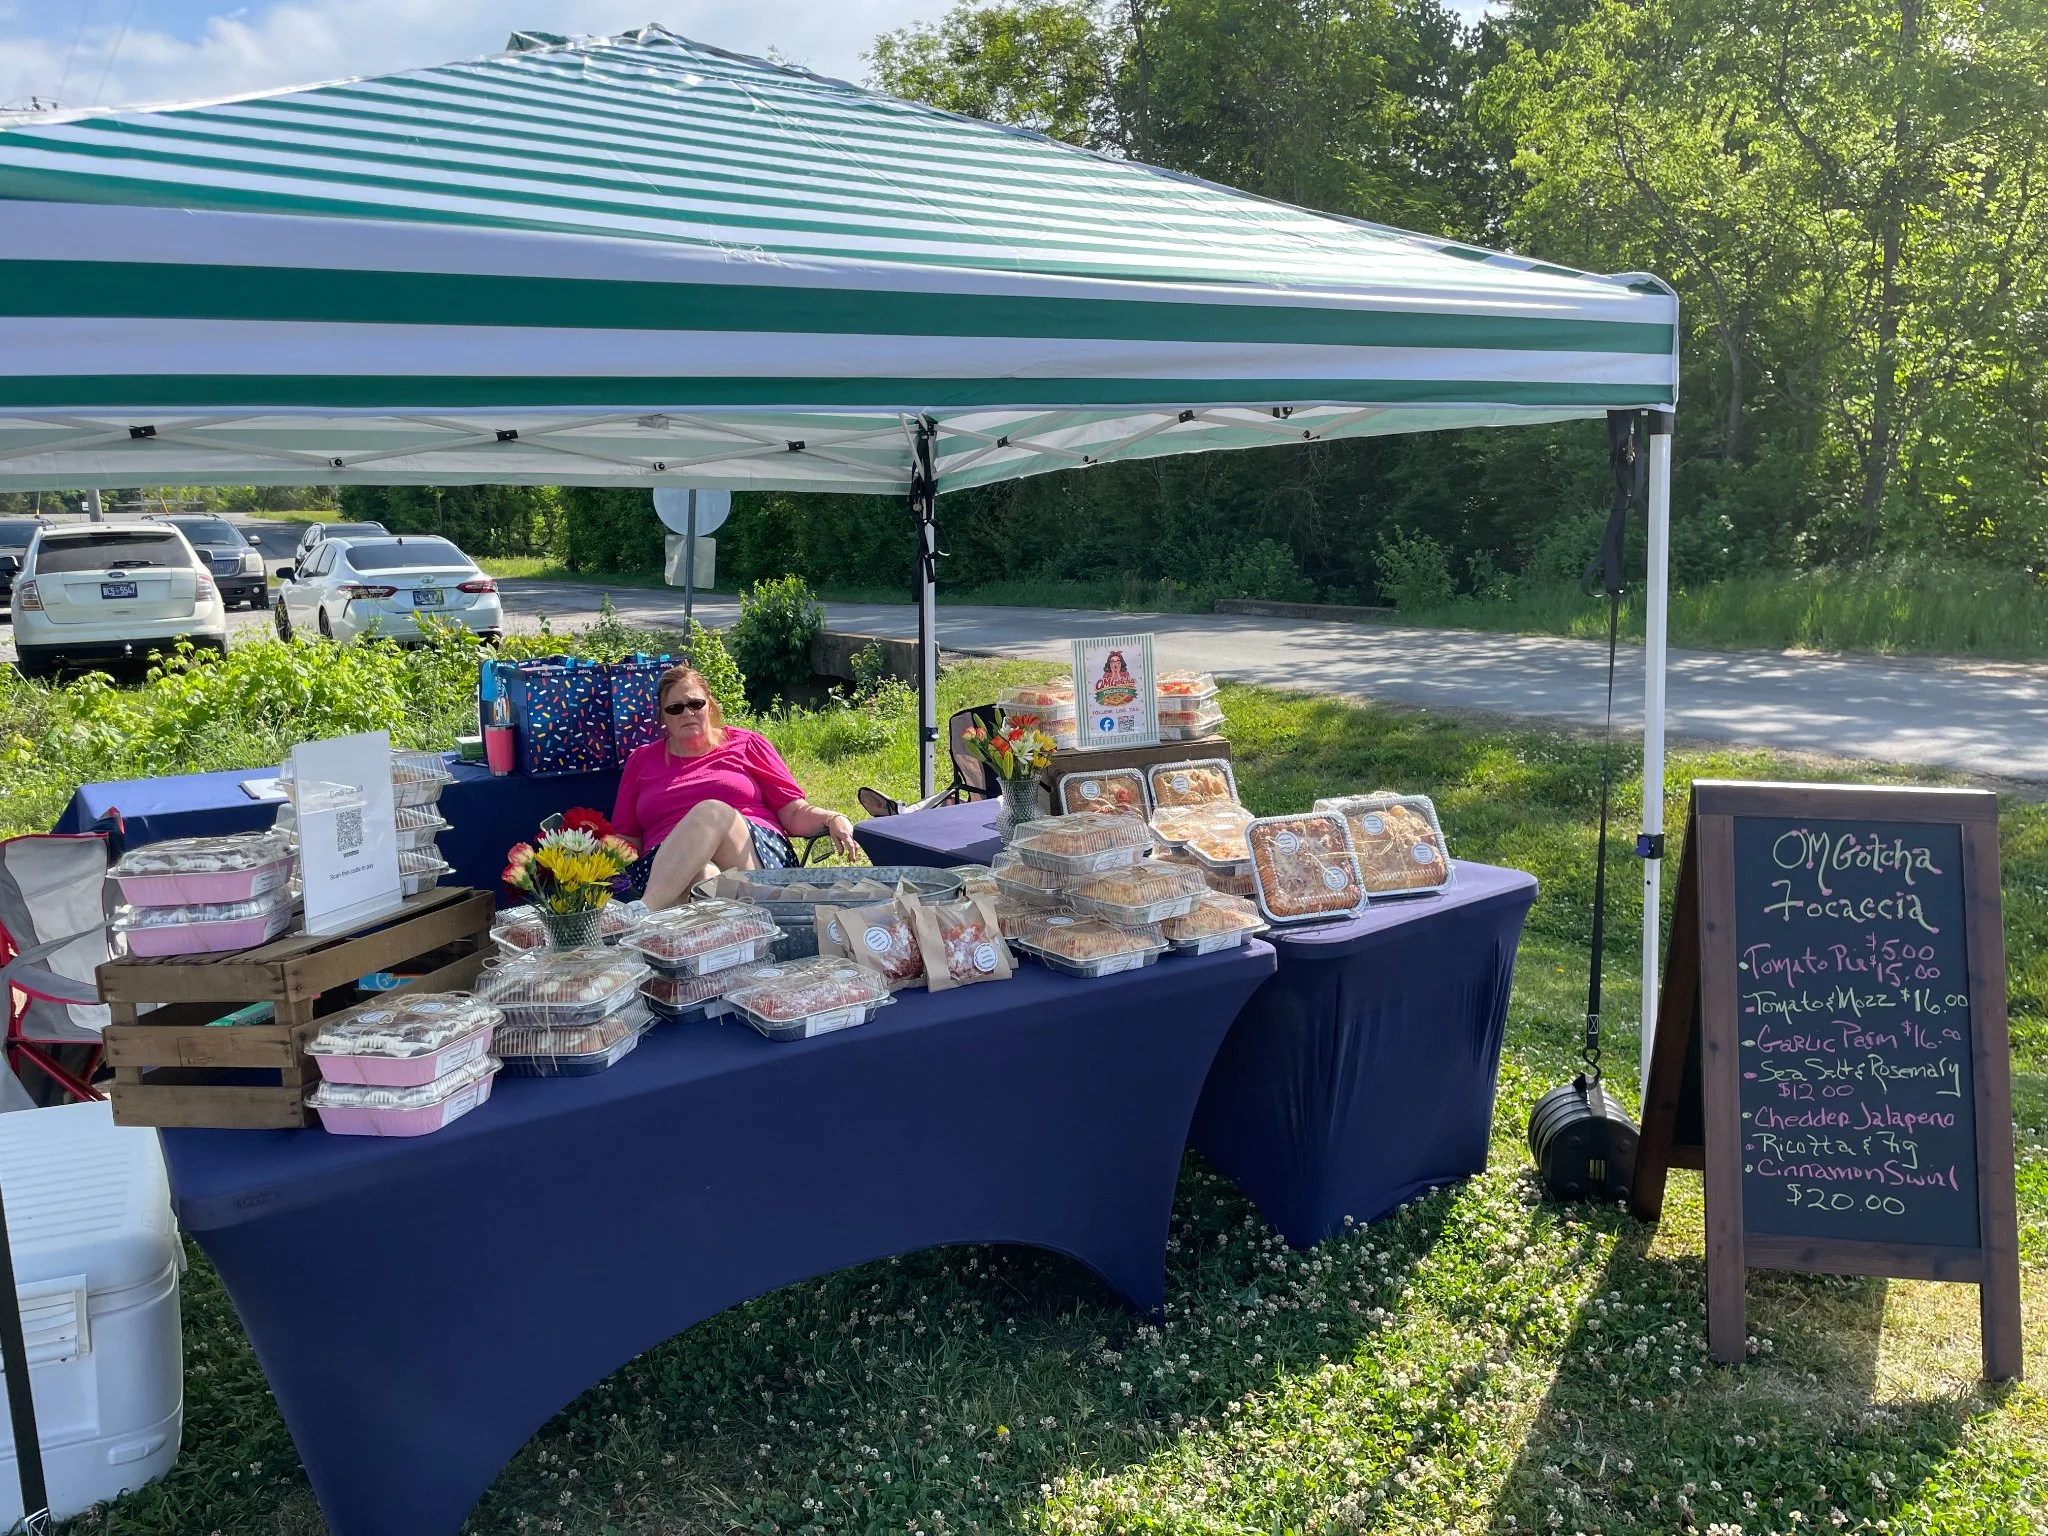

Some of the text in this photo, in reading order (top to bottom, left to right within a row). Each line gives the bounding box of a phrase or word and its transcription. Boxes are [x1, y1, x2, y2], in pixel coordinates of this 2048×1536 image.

[1763, 879, 1940, 934] Focaccia
[1744, 943, 1828, 989] Tomato
[1828, 944, 1869, 973] Pie
[1759, 1060, 1808, 1082] Sea
[1867, 1053, 1961, 1098] Rosemary
[1853, 1101, 1955, 1134] Jalapeno
[1752, 1131, 1918, 1170] Ricotta & Fig
[1757, 1159, 1960, 1192] Cinnamon Swirl
[1786, 1183, 1906, 1215] $20.00
